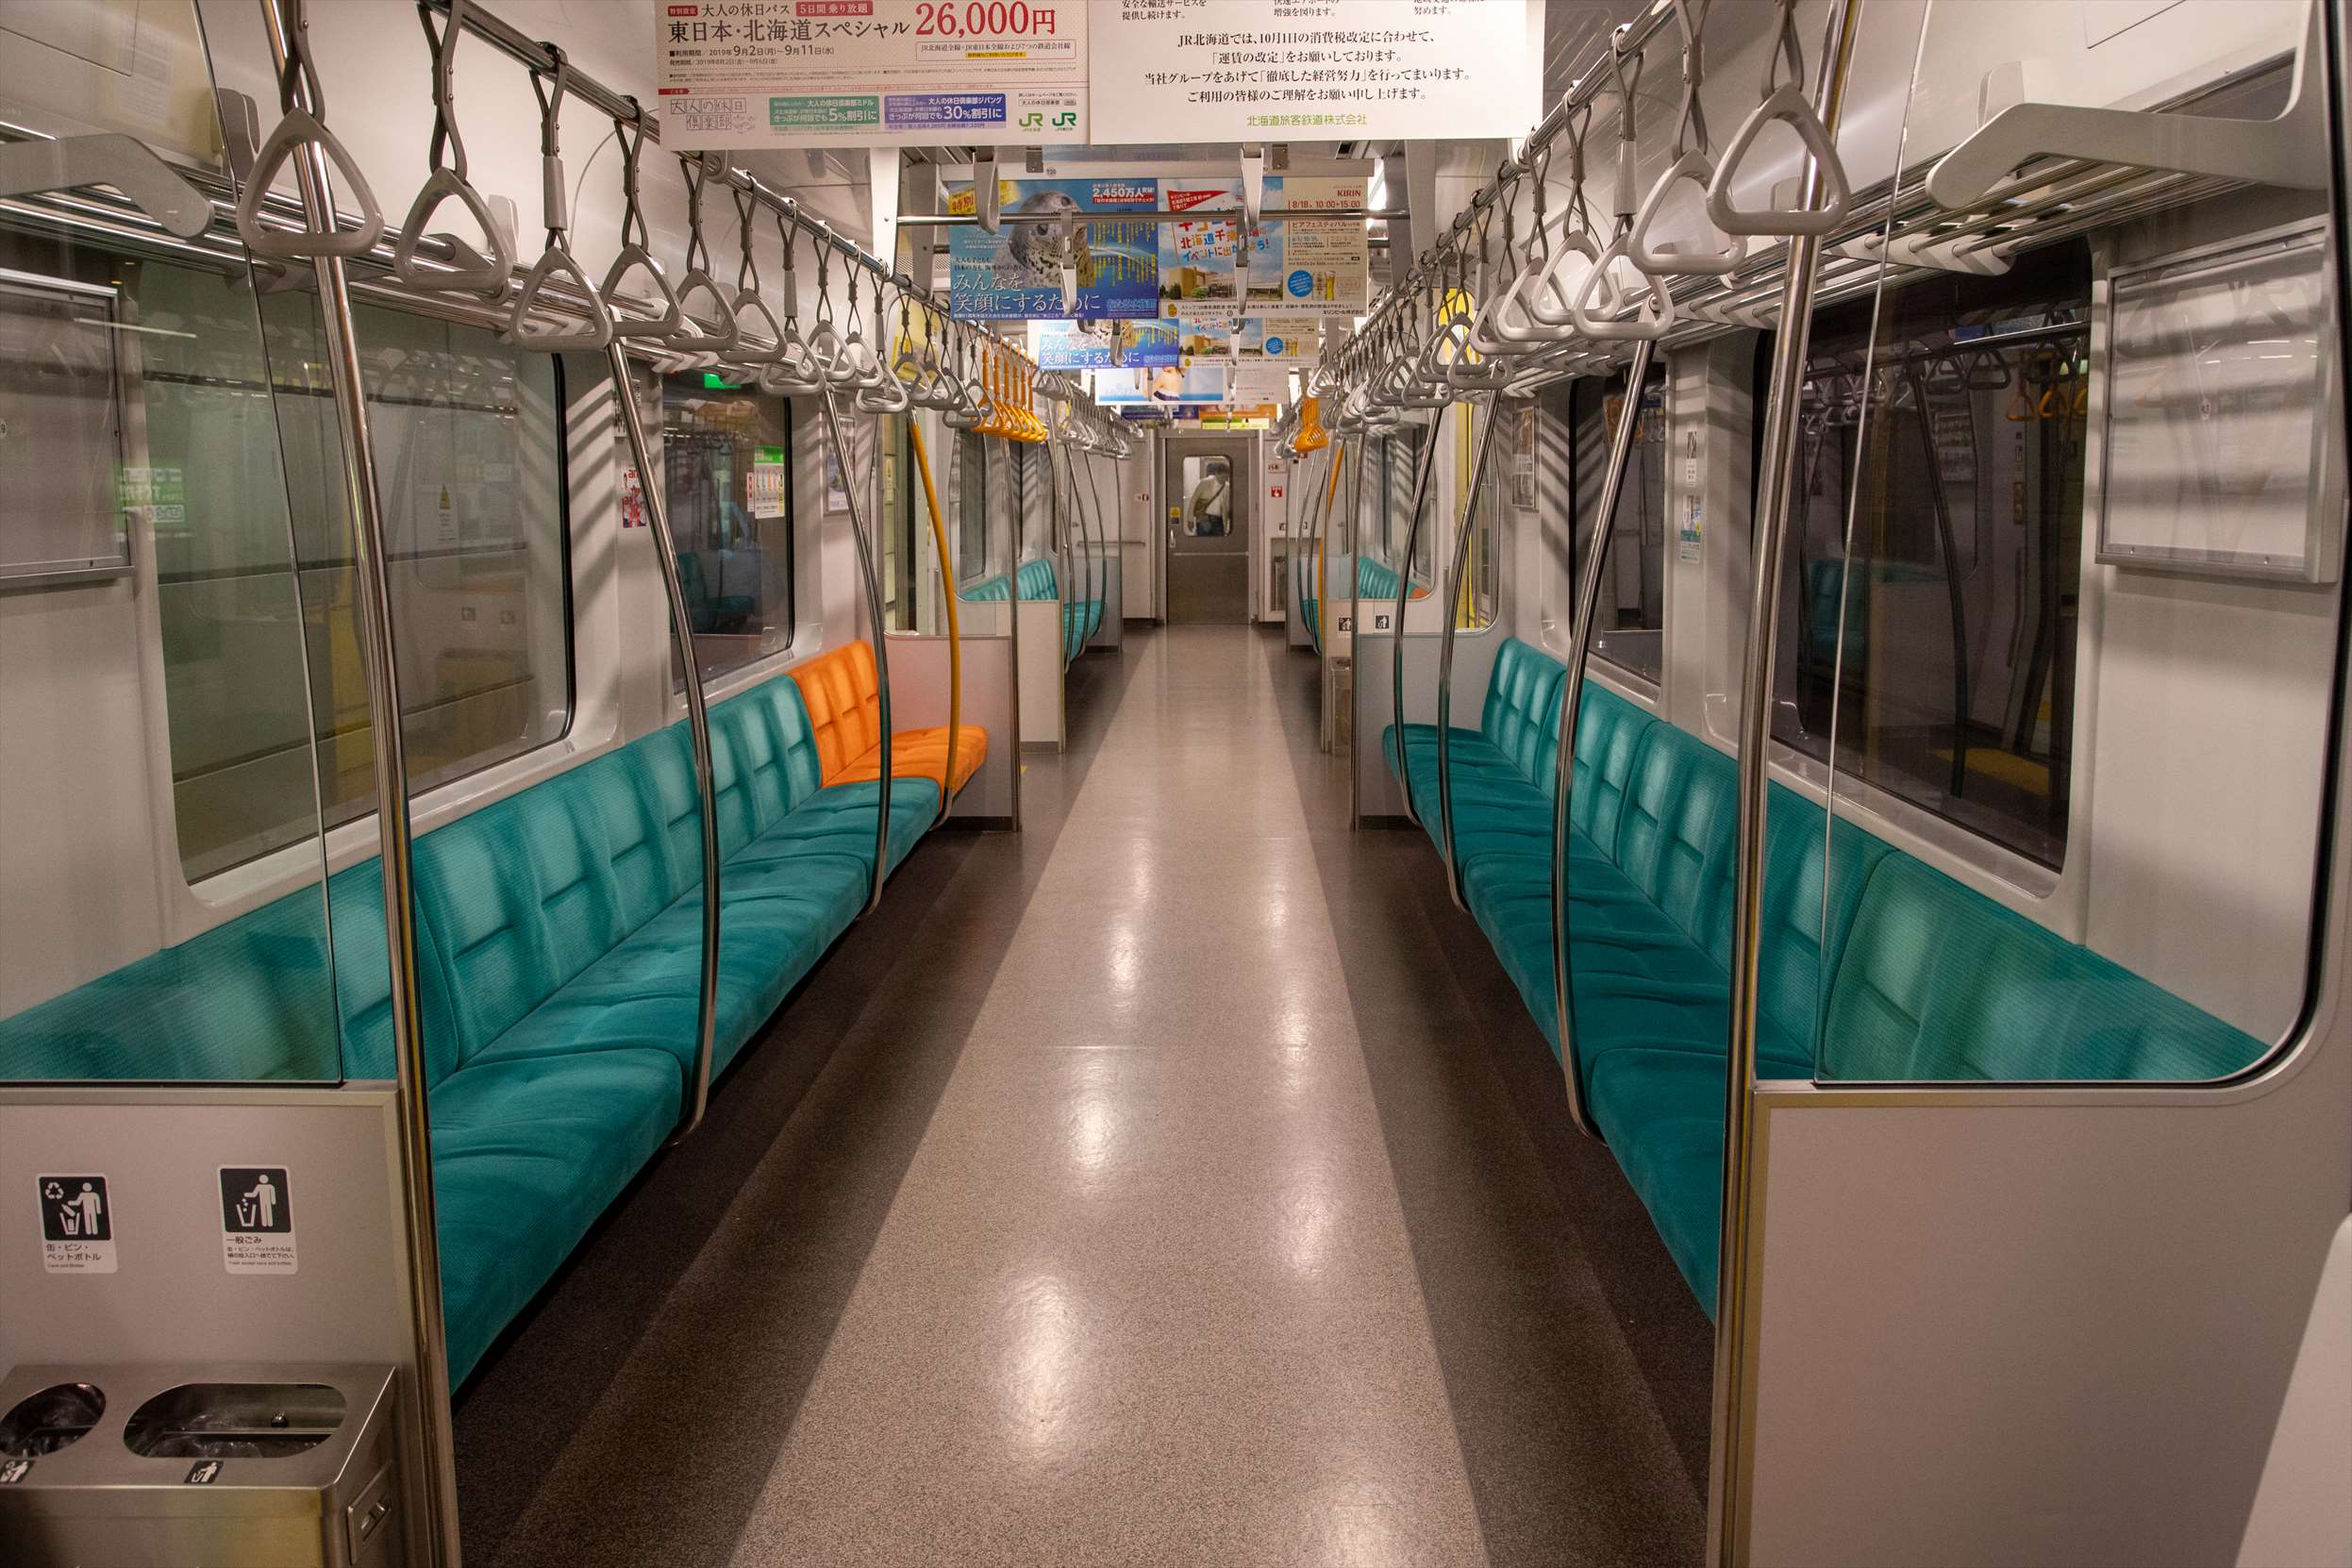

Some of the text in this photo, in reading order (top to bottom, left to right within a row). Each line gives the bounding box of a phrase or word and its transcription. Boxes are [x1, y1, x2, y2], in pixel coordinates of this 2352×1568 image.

[701, 3, 791, 17] 大人の休日パス
[1122, 10, 1186, 21] 提供し続けます。
[1274, 7, 1336, 17] 増強を図ります。
[915, 1, 1056, 38] 26,000円
[667, 19, 910, 43] 東日本・北海道スペシャル
[1177, 30, 1435, 47] JR北海道では、10月1日の消費税改定に合わせて、
[1211, 50, 1402, 64] 「運賃の改定」をお願いしております。
[1144, 68, 1470, 86] 当社グループをあげて「徹底した経営努力」を行ってまいります。
[1187, 87, 1426, 103] ご利用の皆様のご理解をお願い申し上げます。
[1018, 112, 1043, 127] JR
[1052, 112, 1077, 127] JR
[1246, 113, 1367, 126] 北海道旅客鉄道株式会社
[953, 272, 1024, 292] みんなを
[1042, 351, 1140, 365] 笑顔にするたに
[225, 1235, 263, 1245] 一般ごみ
[46, 1252, 102, 1261] ペットボトル
